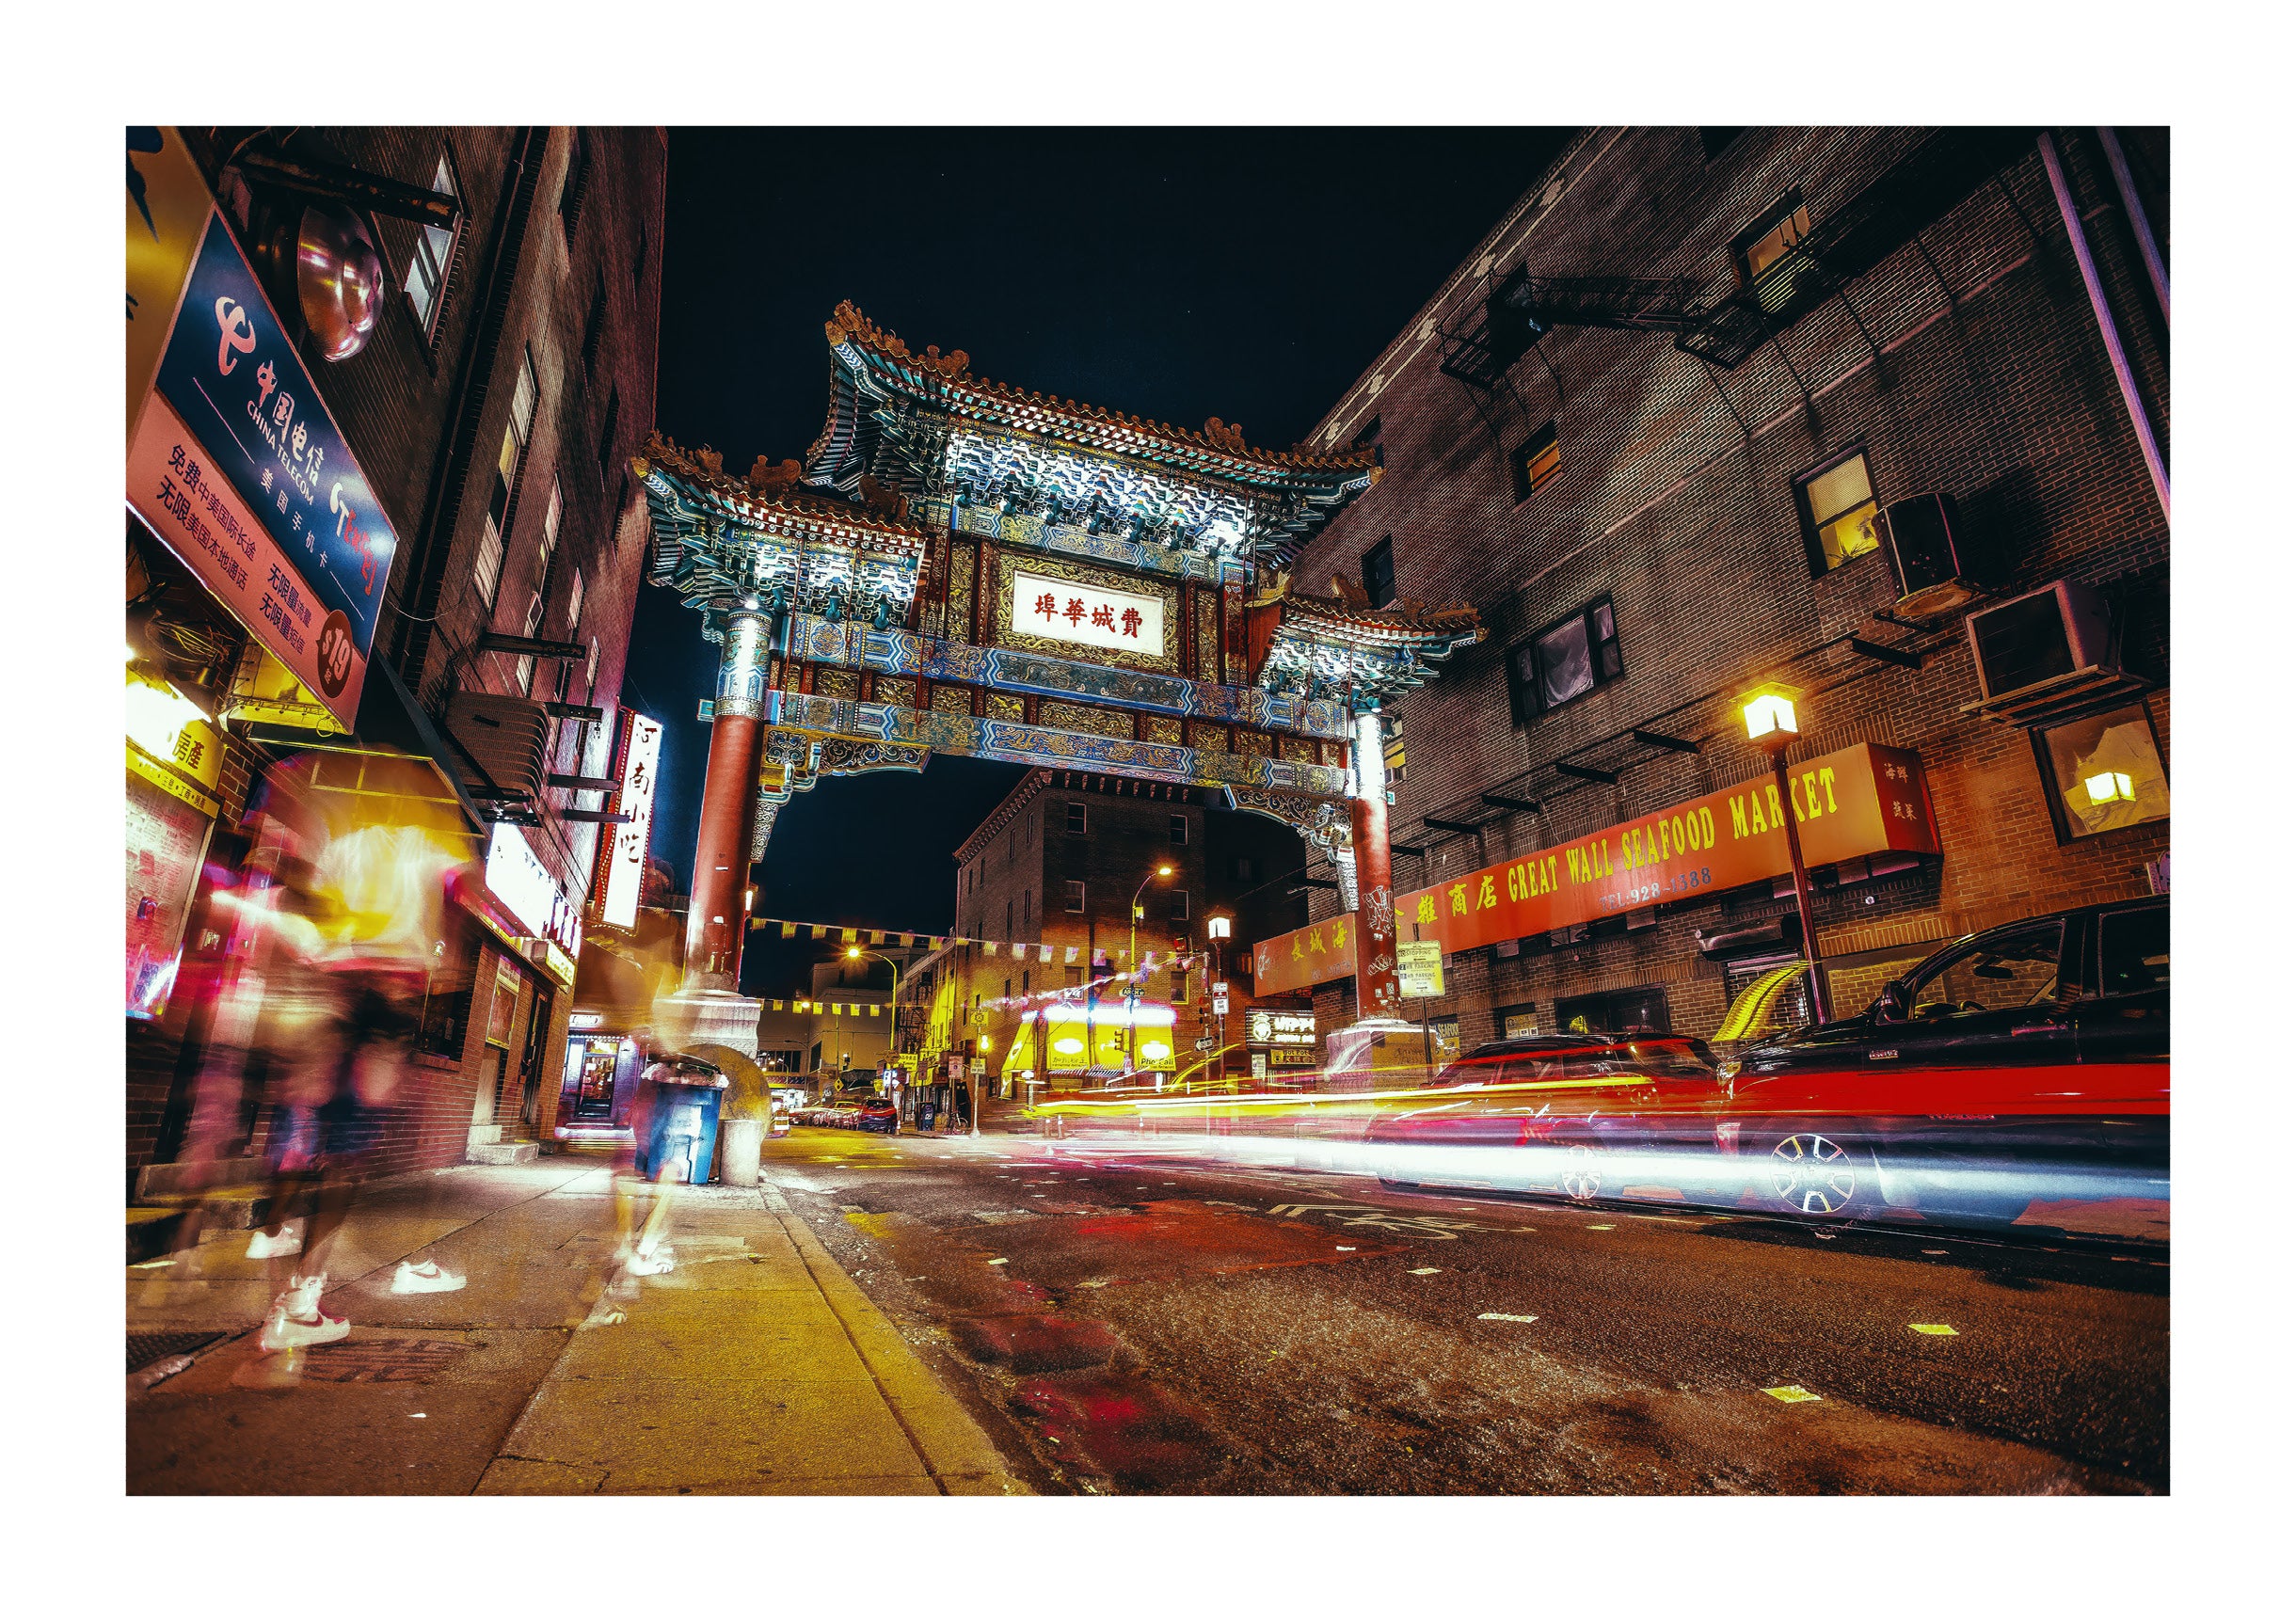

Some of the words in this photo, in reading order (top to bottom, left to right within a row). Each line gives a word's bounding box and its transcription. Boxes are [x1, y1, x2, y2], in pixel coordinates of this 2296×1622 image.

[247, 400, 277, 451] CHINA
[277, 443, 314, 506] TELECOM
[257, 360, 325, 487] 中国电信
[156, 475, 249, 593] 无限美国本地通话
[167, 444, 257, 562] 免费中美国际长途
[1507, 855, 1559, 903] GREAT
[1565, 838, 1614, 886] WALL
[1621, 805, 1715, 871] SEAFOOD
[1728, 766, 1838, 840] MARKET
